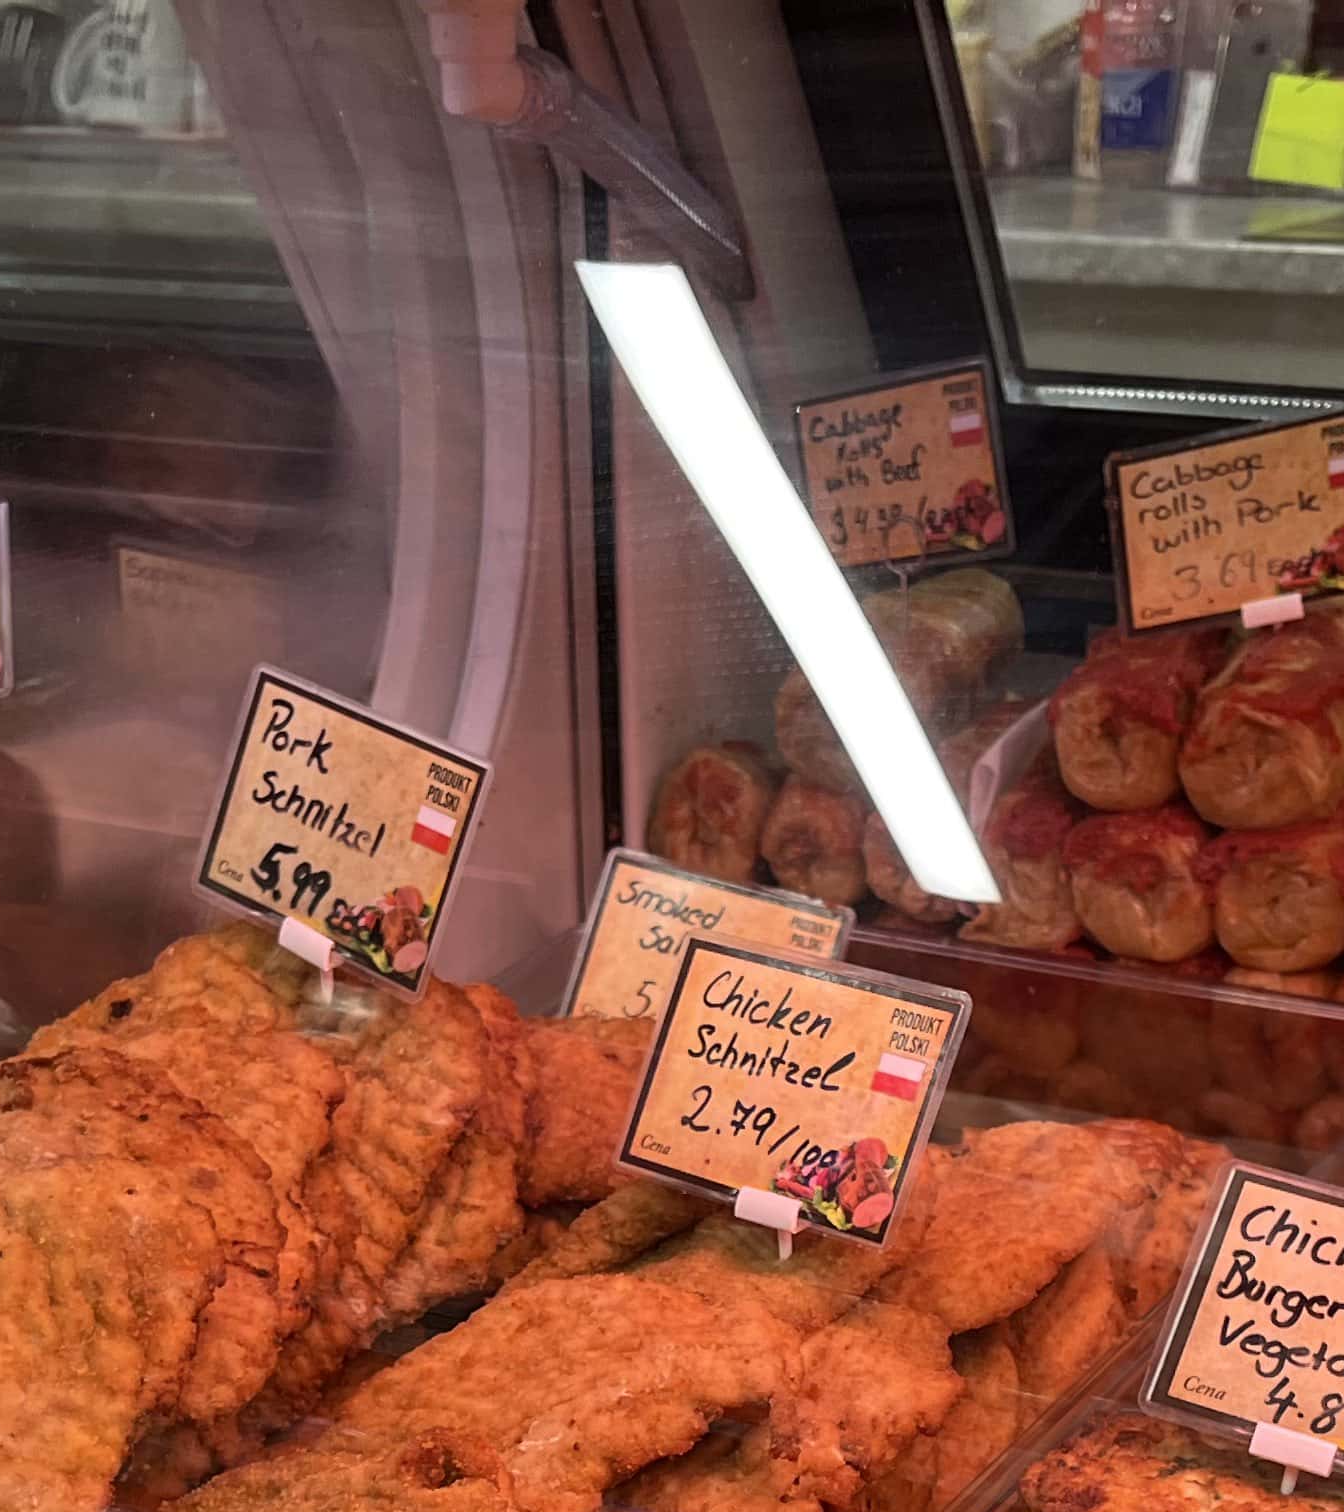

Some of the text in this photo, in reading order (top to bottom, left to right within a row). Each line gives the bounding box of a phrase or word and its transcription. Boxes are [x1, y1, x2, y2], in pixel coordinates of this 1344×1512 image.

[1130, 453, 1265, 500] Cabbage
[1138, 493, 1207, 525] rolls
[1151, 490, 1323, 554] with Pork
[261, 698, 333, 775] Pork
[425, 784, 461, 811] POLSKI
[427, 762, 473, 794] PRODUKT
[252, 770, 387, 858] Schnitzel
[249, 842, 331, 918] 5.99
[616, 880, 726, 931] Smoked
[703, 970, 832, 1040] Chicken
[890, 1007, 945, 1036] PRODUKT
[687, 1023, 856, 1092] Schnitzel
[889, 1031, 930, 1057] POLSKI
[1183, 1374, 1228, 1402] Cena
